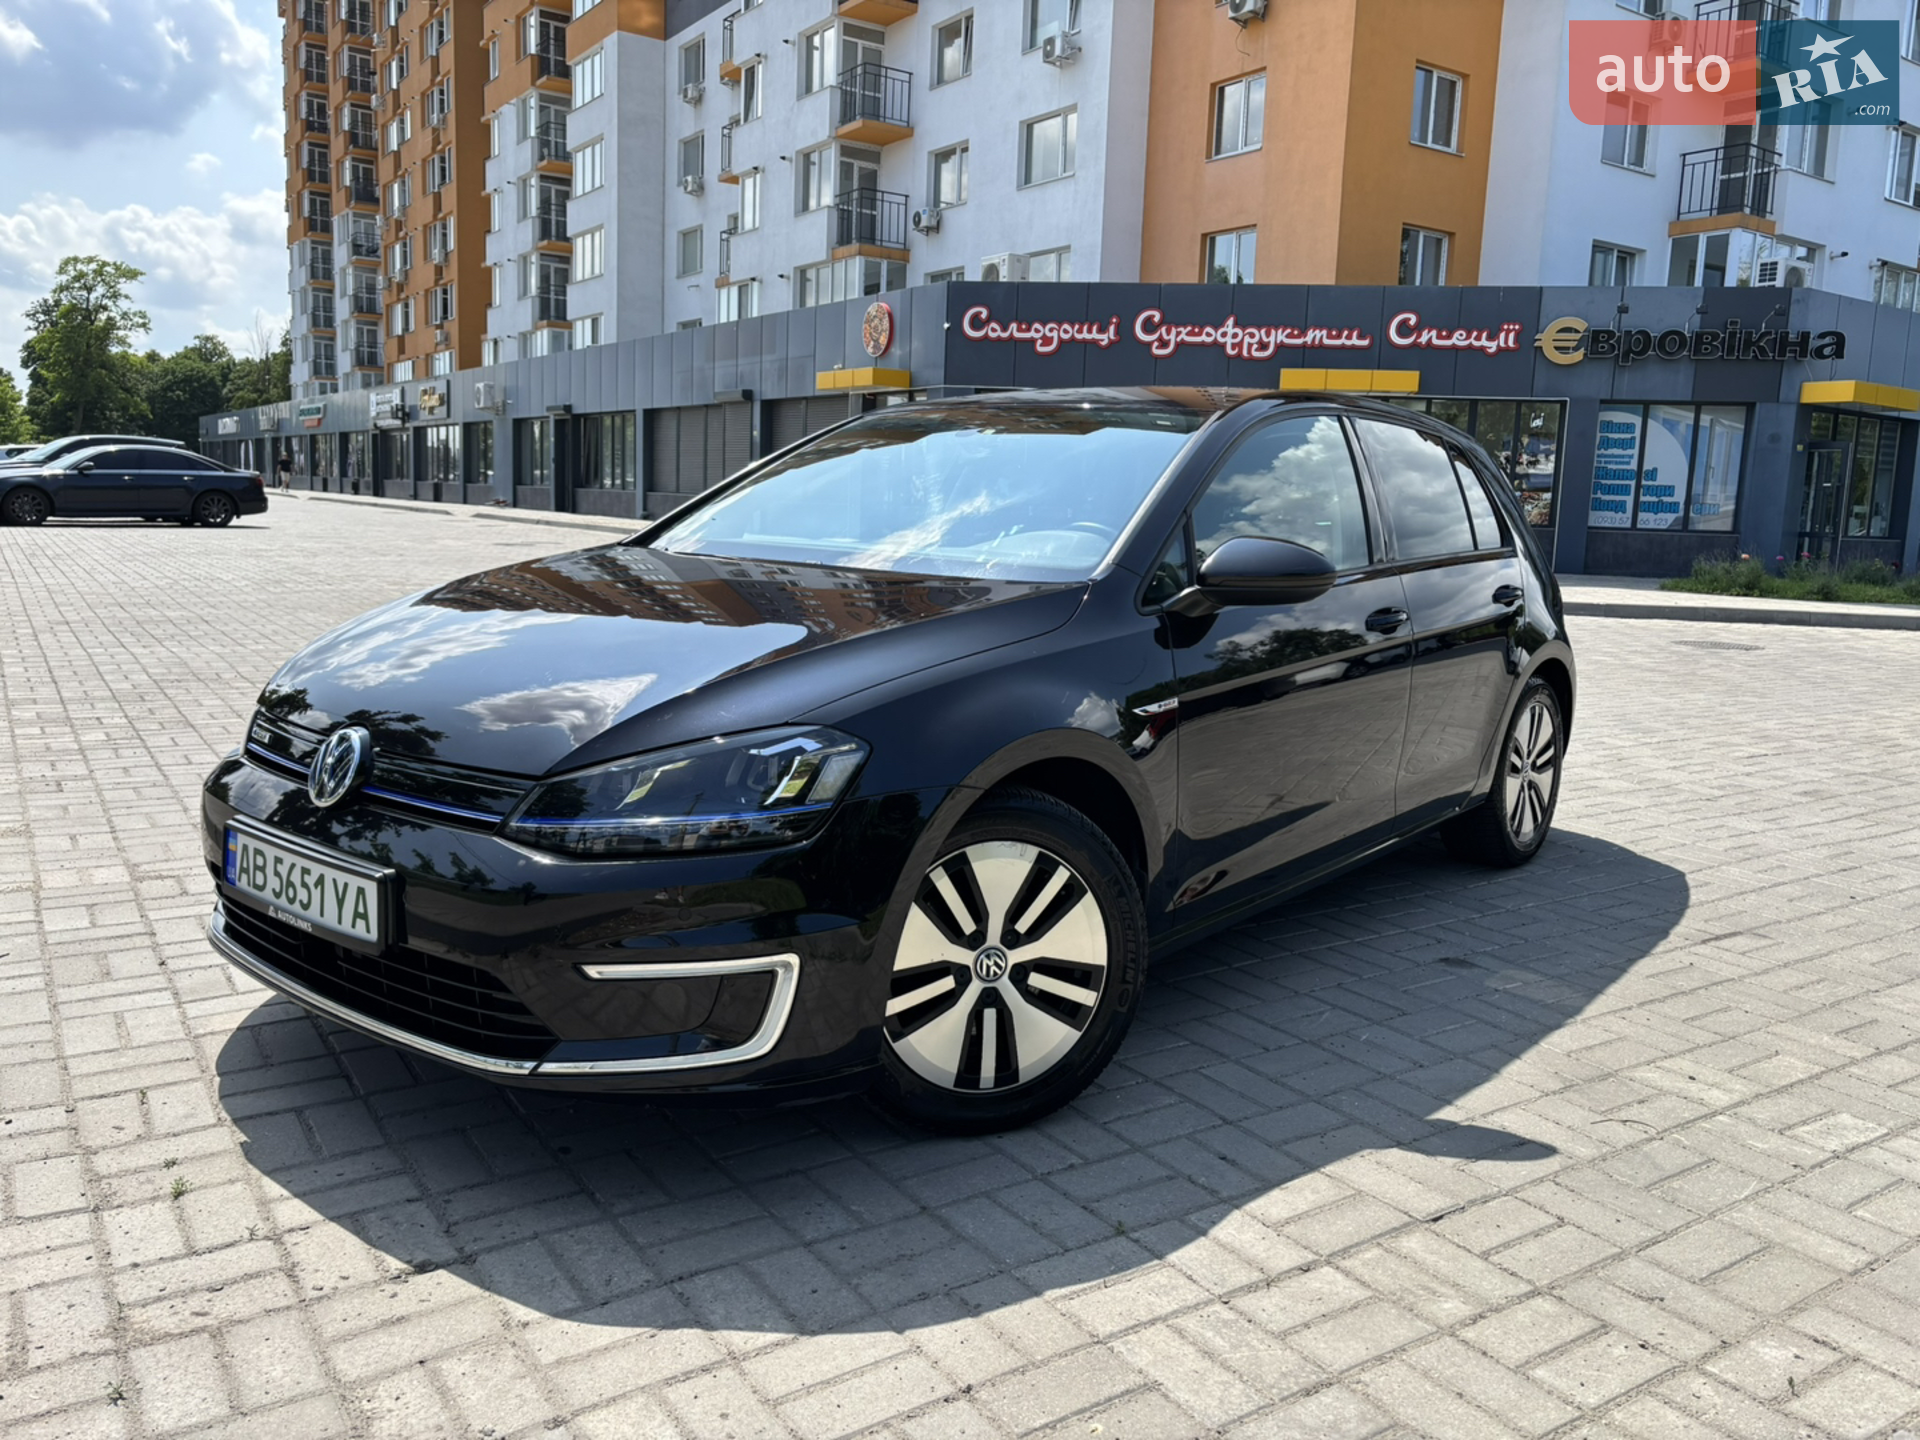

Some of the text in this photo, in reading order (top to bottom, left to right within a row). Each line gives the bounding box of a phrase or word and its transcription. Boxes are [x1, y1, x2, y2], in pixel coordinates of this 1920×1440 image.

[962, 305, 1522, 359] Солодощі Сухофрукти Спеції
[1597, 436, 1636, 450] Двері
[1599, 420, 1636, 434] Вікна
[1117, 896, 1137, 985] MICHELIN
